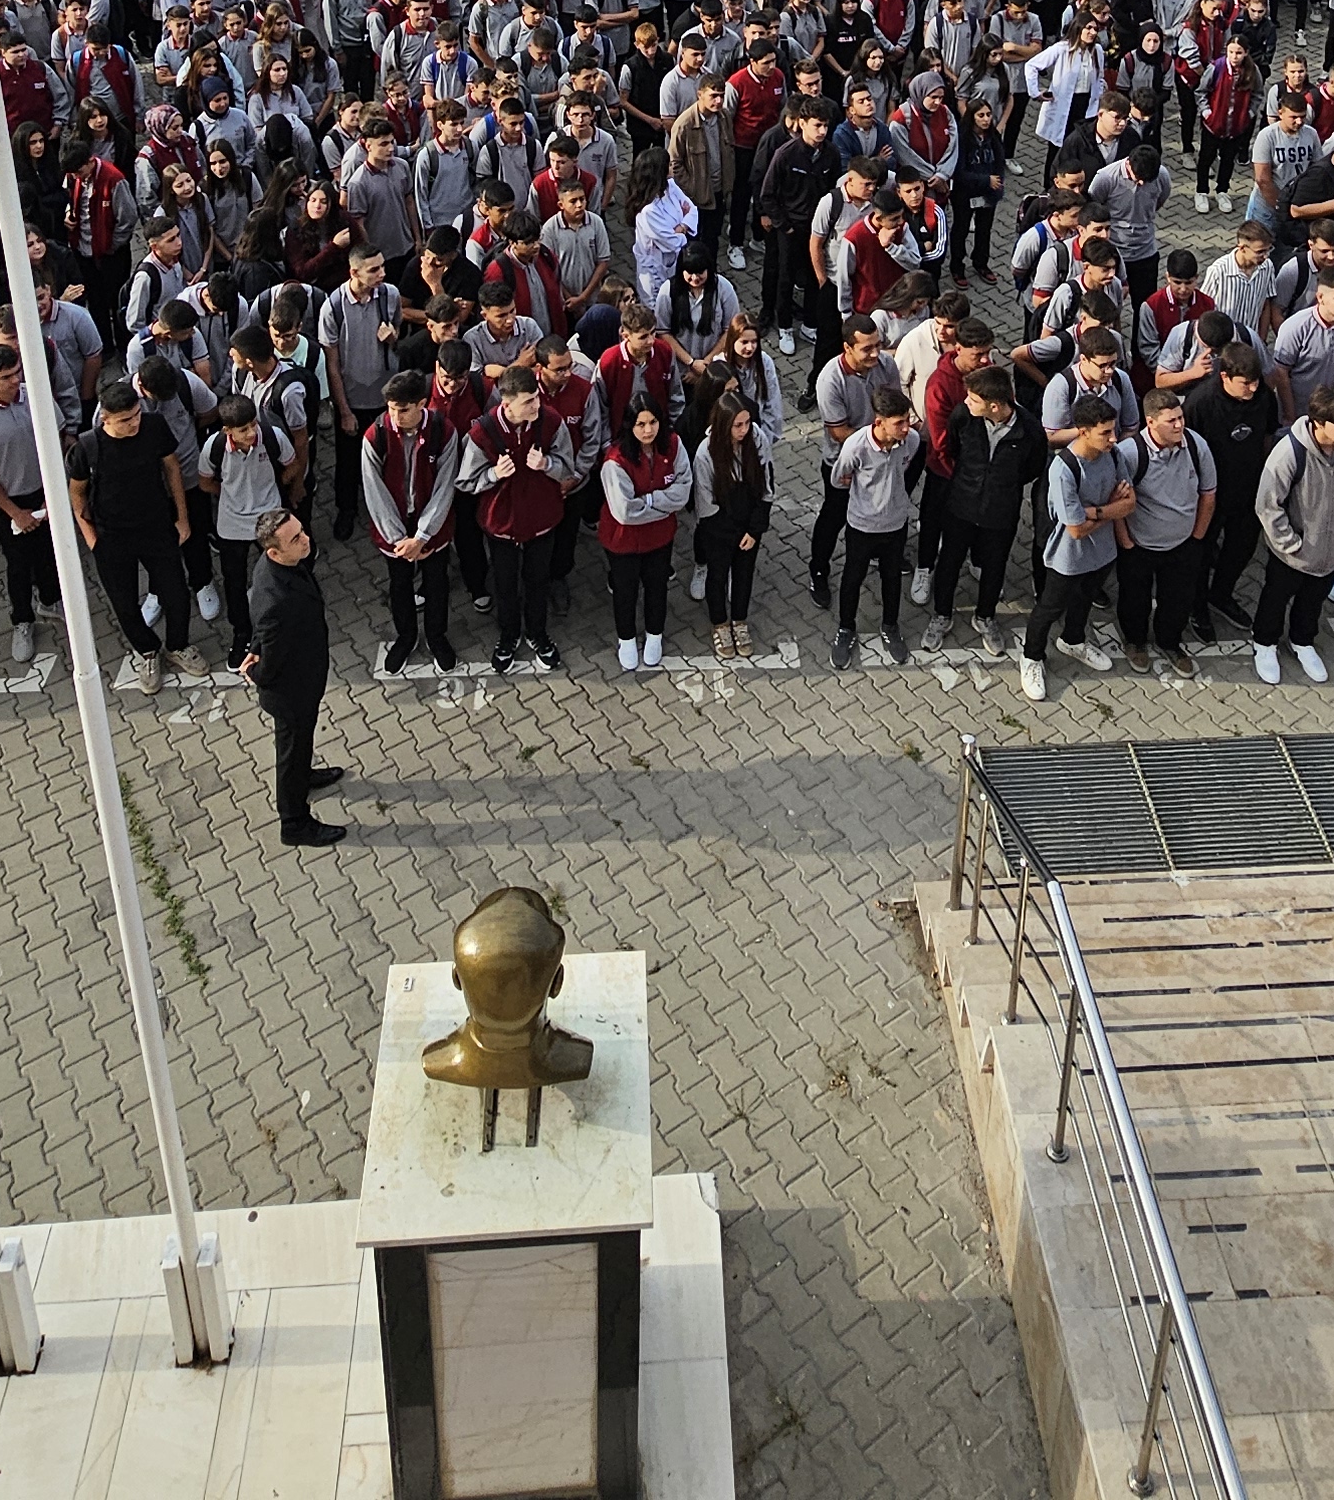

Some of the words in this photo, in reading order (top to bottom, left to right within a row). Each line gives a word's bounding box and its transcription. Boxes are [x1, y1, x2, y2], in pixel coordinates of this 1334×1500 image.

[566, 415, 582, 425] RSP
[433, 676, 494, 709] 16
[674, 669, 738, 704] 15
[168, 690, 229, 724] 17
